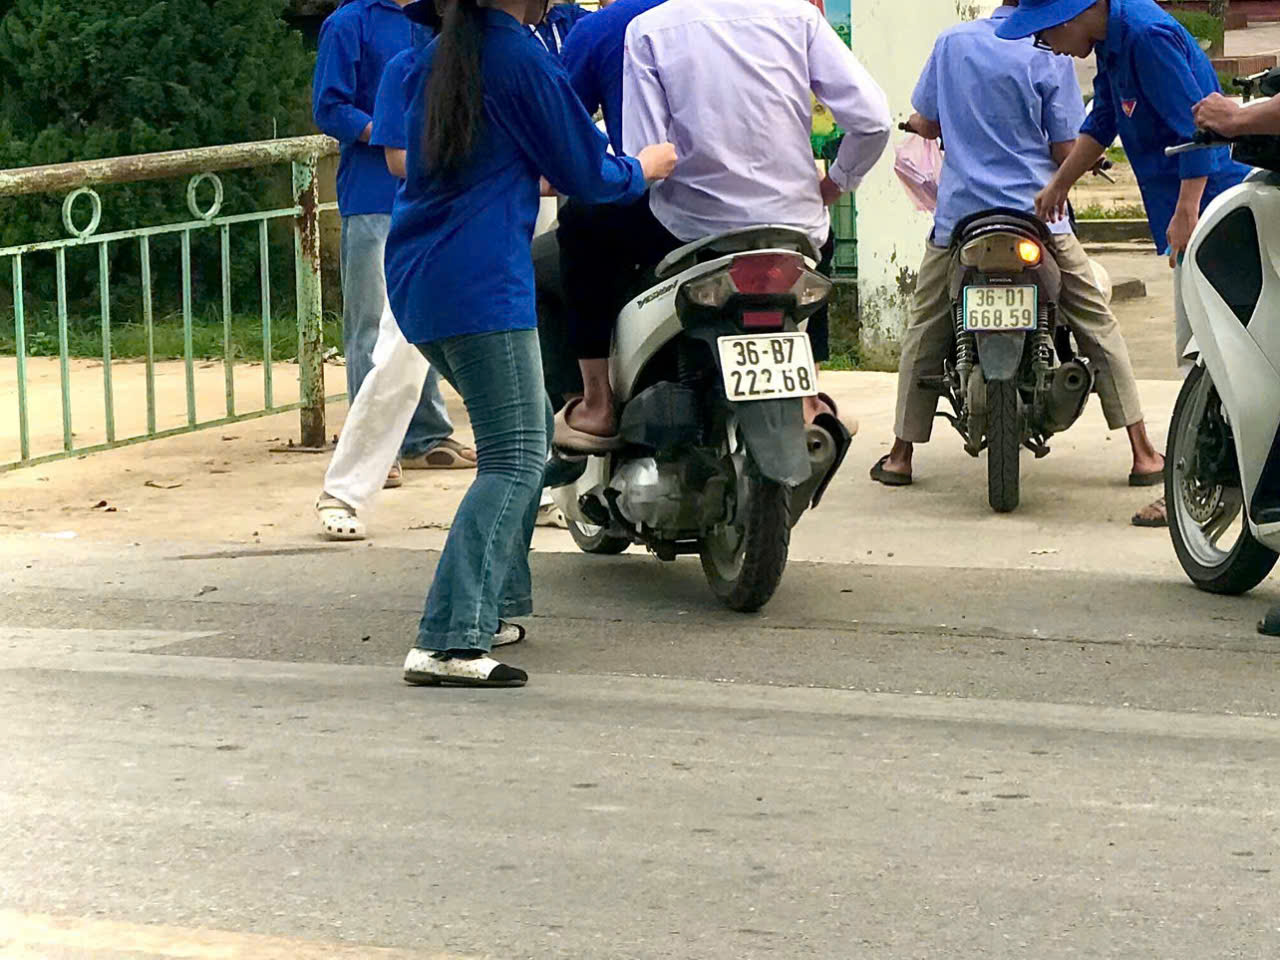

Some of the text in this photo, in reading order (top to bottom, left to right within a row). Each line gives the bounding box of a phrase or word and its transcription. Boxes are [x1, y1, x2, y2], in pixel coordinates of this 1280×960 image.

[976, 288, 1024, 307] 36-D1
[969, 309, 1032, 328] 668.59
[732, 338, 795, 366] 36-B7
